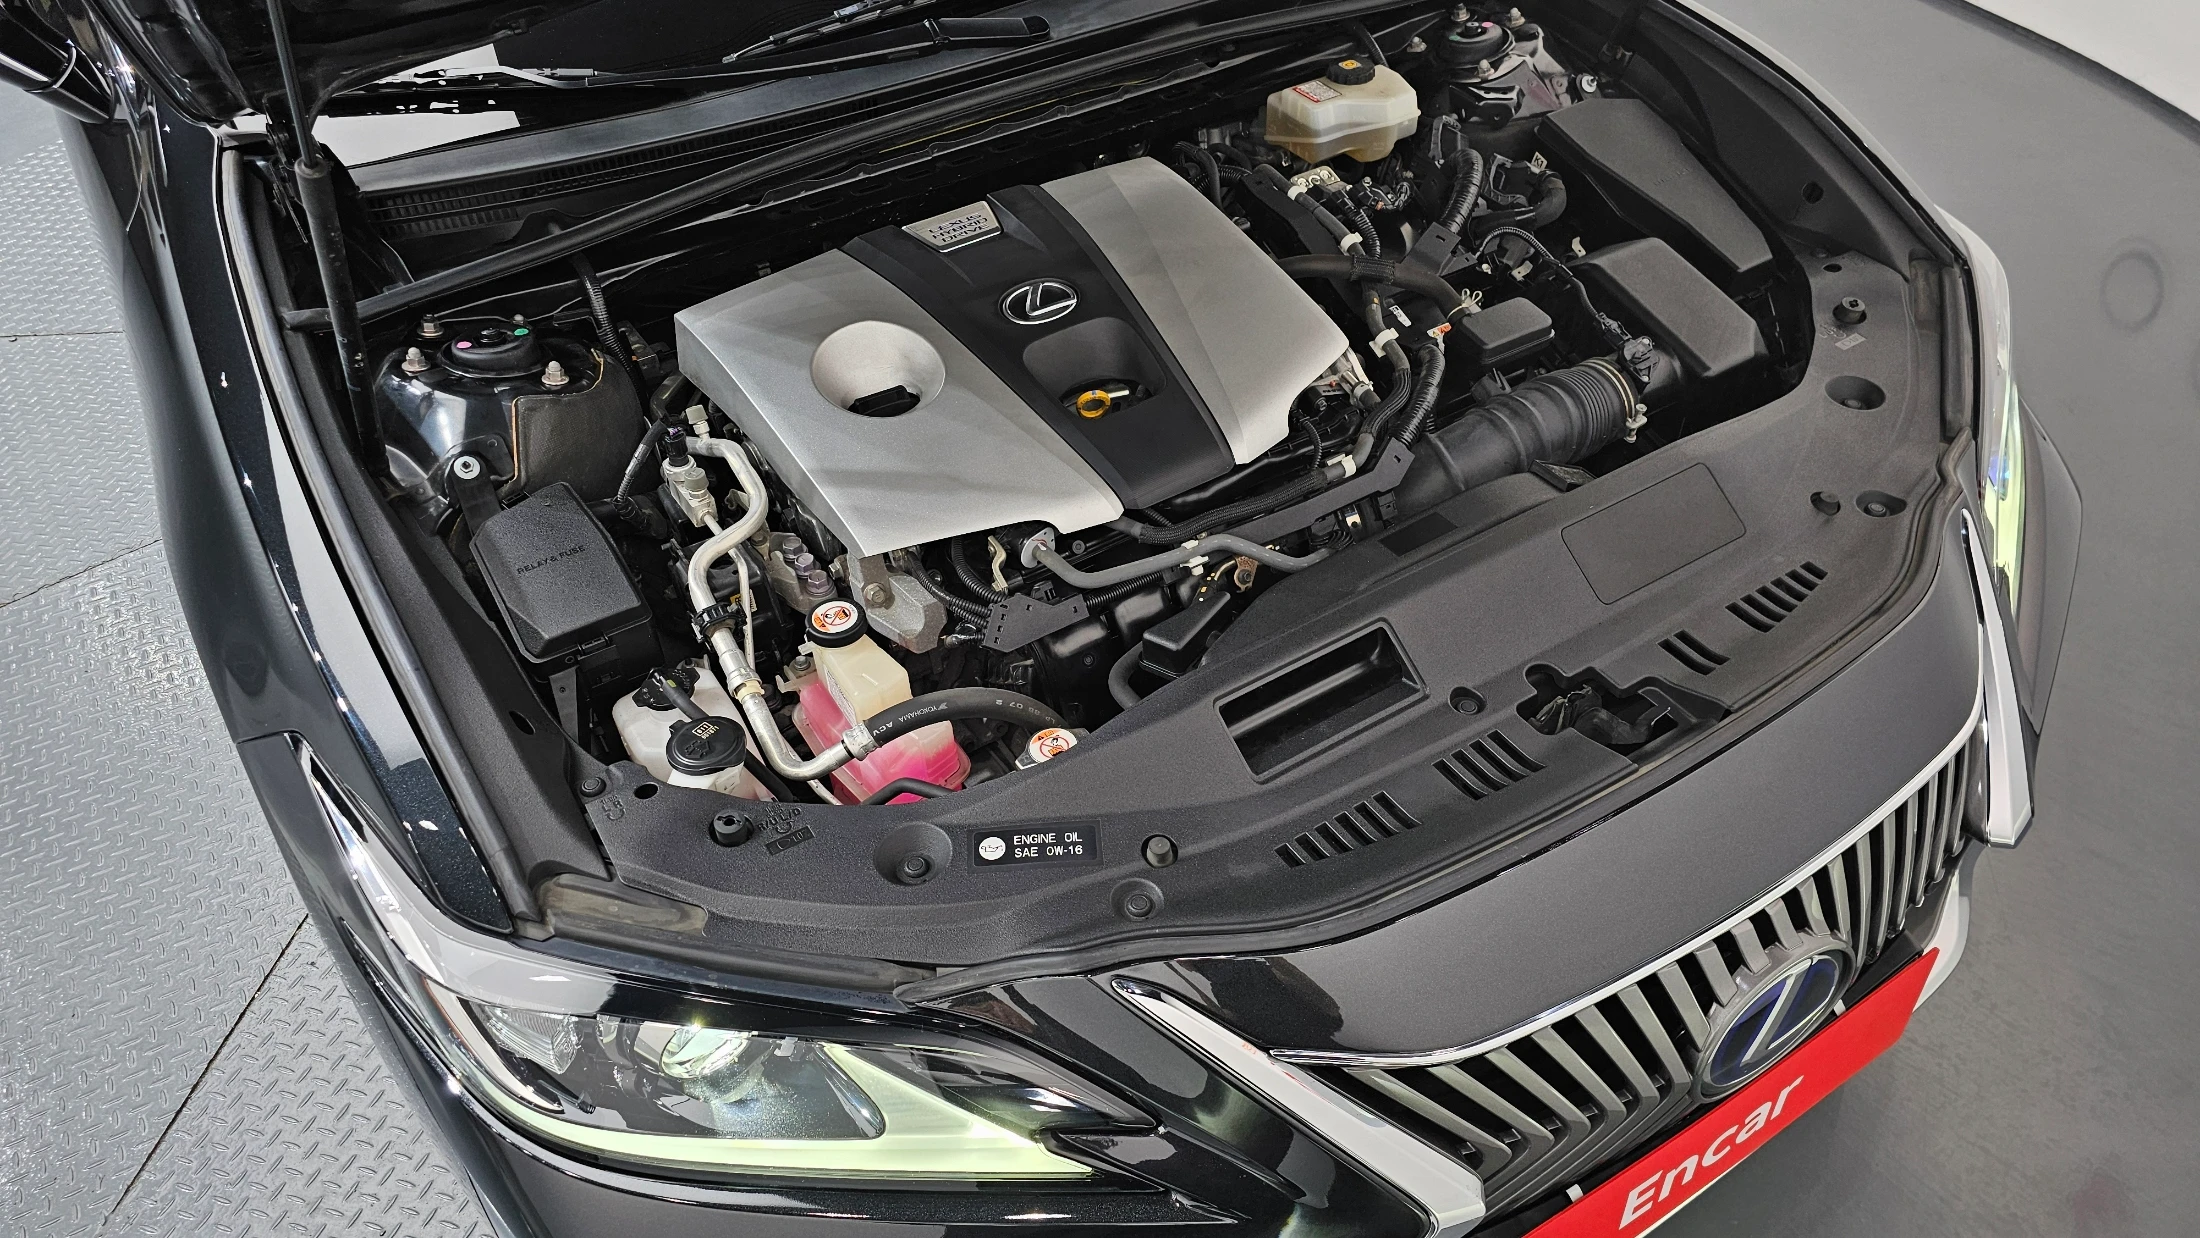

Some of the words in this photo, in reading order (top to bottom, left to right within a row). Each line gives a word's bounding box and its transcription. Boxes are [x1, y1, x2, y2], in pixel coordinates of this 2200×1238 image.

[928, 212, 982, 233] LEXUS
[932, 217, 988, 239] HYBRID
[941, 224, 990, 243] DRIVE
[517, 557, 549, 574] RELAY
[559, 545, 586, 558] FUSE
[898, 705, 938, 723] YOKOHAMA
[872, 721, 893, 736] ACV
[1013, 833, 1057, 845] ENGINE
[1064, 832, 1083, 843] OIL
[1014, 847, 1039, 858] SAE
[1046, 845, 1083, 856] 0W-16
[1618, 1075, 1805, 1231] Encar
